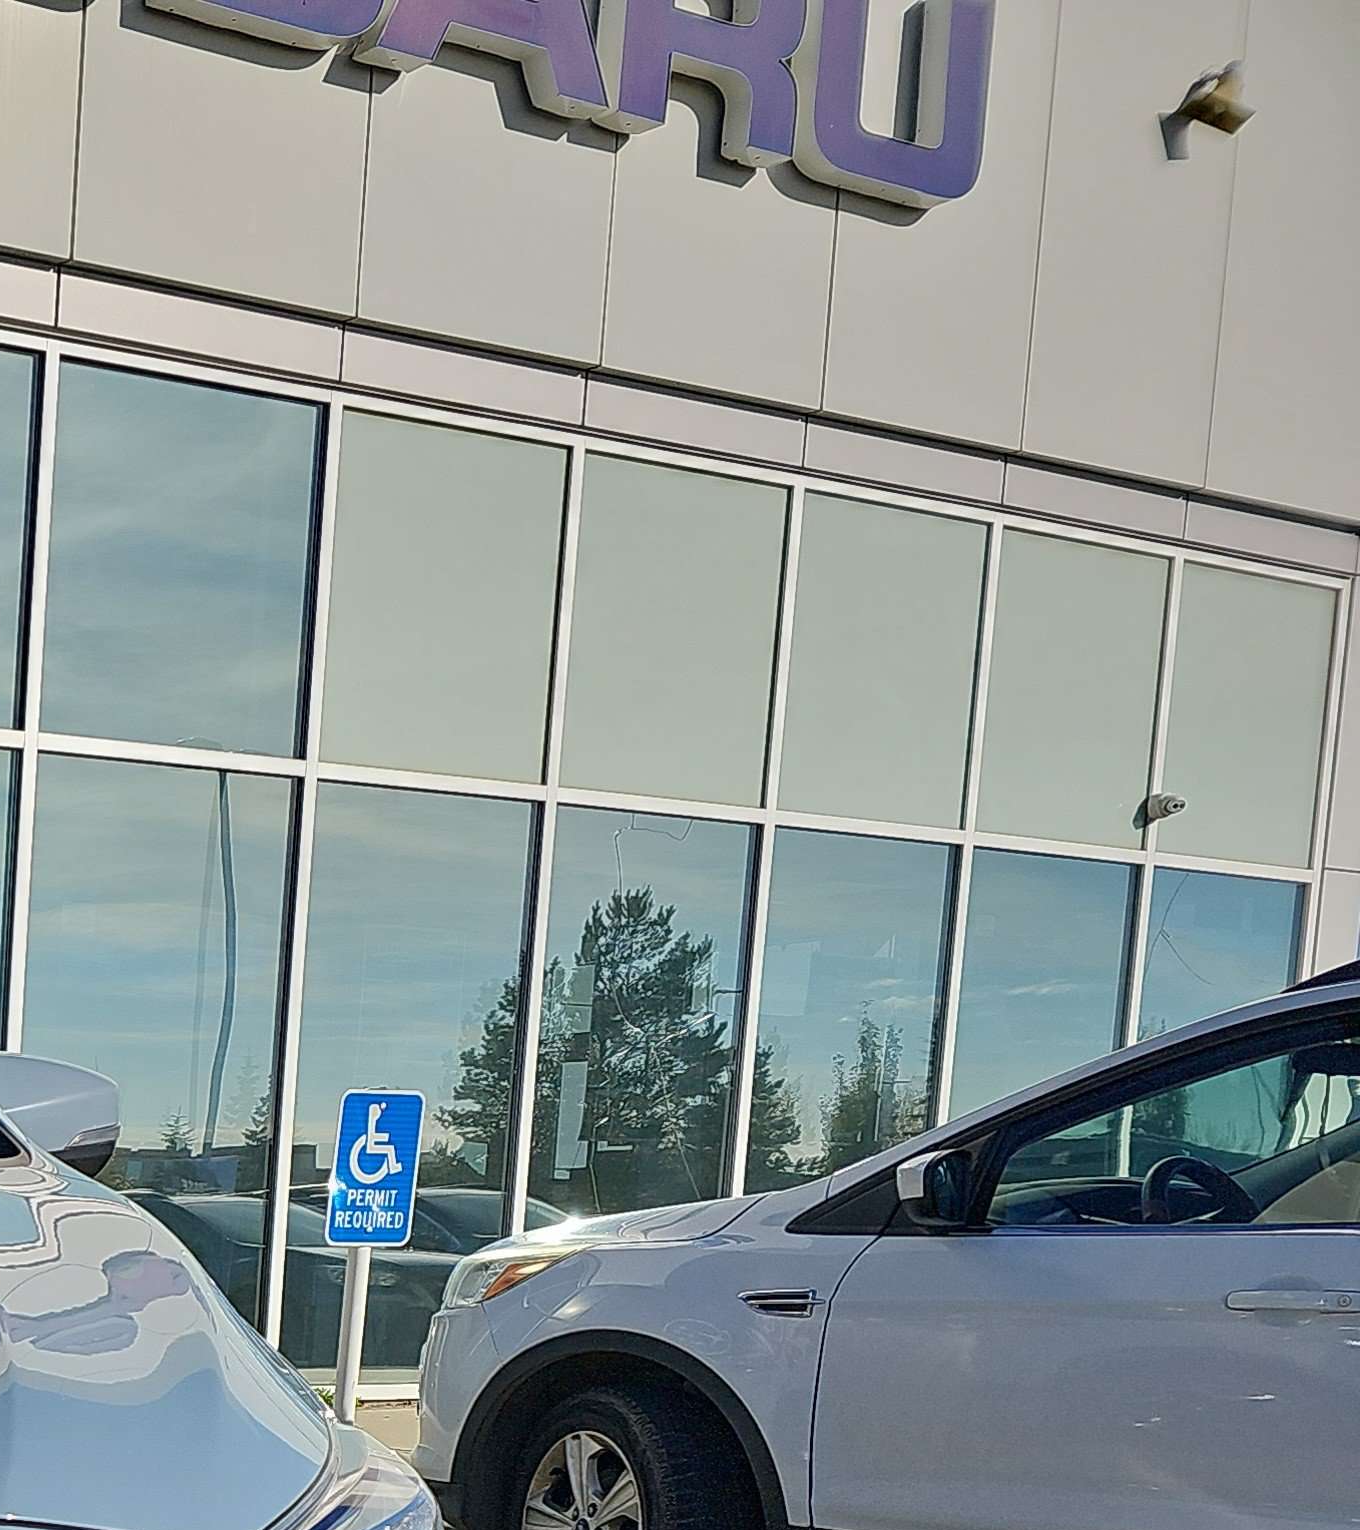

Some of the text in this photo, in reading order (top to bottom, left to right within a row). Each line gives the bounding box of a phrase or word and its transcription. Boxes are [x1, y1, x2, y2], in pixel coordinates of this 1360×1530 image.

[145, 0, 986, 206] ARU
[346, 1189, 398, 1207] PERMIT
[334, 1211, 404, 1229] REQUIRED
